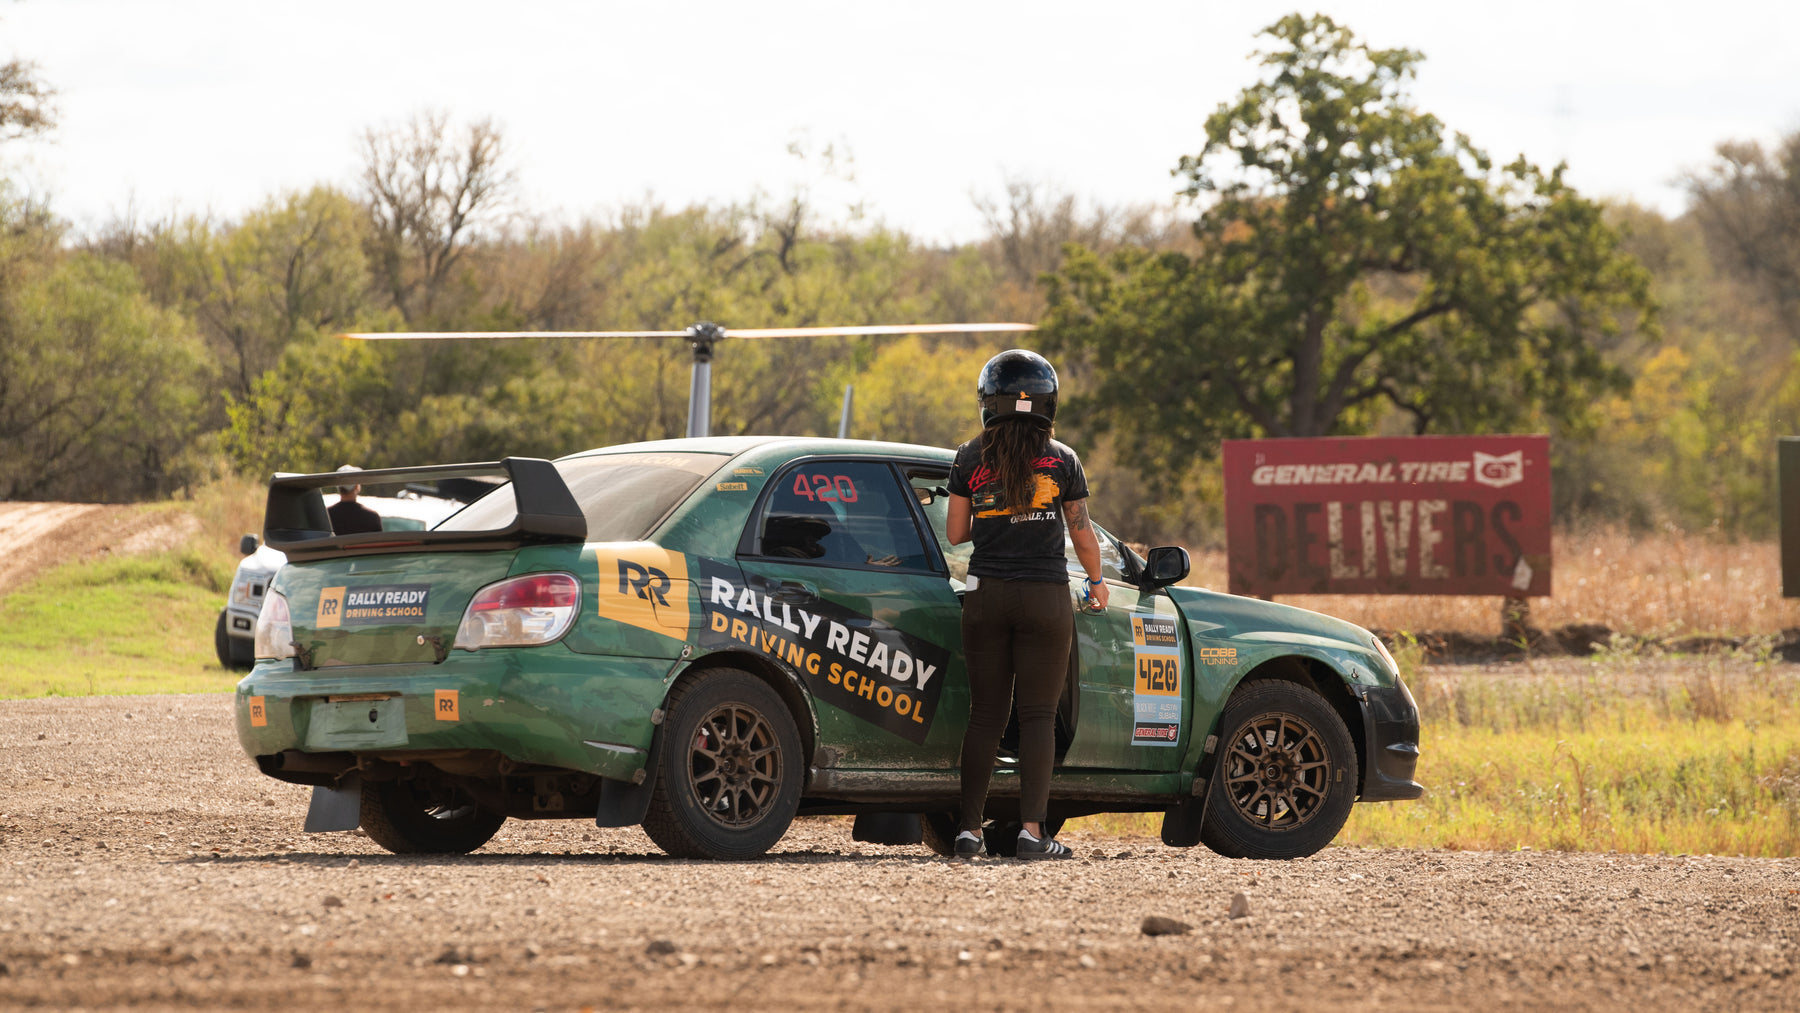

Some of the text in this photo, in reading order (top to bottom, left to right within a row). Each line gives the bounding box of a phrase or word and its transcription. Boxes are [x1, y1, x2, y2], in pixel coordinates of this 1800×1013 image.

[1252, 462, 1397, 485] GENERAL
[1399, 461, 1472, 483] TIRE
[793, 473, 858, 503] 420
[1046, 511, 1056, 520] TX
[1254, 499, 1523, 581] DELIVERS
[617, 558, 672, 608] RR
[348, 590, 427, 606] RALLY READY
[322, 598, 338, 615] RR
[346, 606, 424, 618] DRIVING SCHOOL
[711, 576, 937, 692] RALLY READY
[1144, 623, 1174, 634] RALLY READY
[1200, 647, 1237, 657] COBB
[710, 610, 925, 724] DRIVING SCHOOL
[1200, 657, 1238, 666] TUNING
[1139, 659, 1177, 692] 420
[252, 705, 262, 718] RR
[439, 698, 454, 711] RR
[1135, 727, 1157, 737] GENERAL
